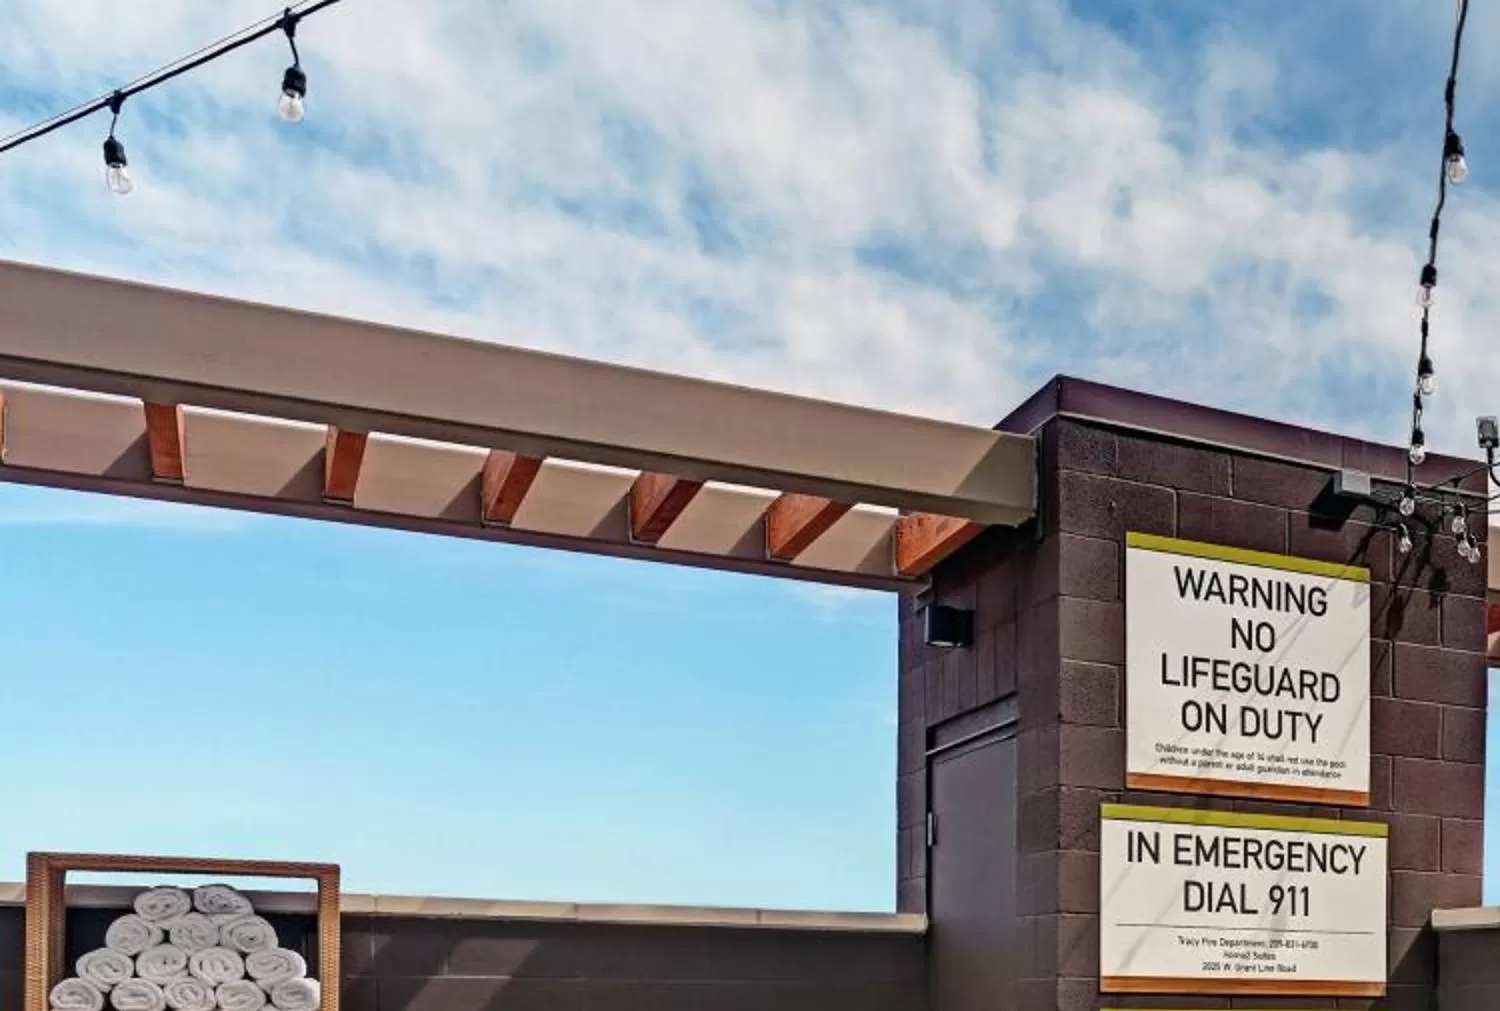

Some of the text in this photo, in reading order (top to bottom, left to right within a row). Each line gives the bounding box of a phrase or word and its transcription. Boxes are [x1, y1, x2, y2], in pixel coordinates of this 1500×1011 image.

[1173, 565, 1328, 616] WARNING
[1231, 617, 1276, 653] NO
[1161, 652, 1340, 703] LIFEGUARD
[1181, 700, 1323, 743] ON DUTY
[1127, 831, 1366, 875] IN EMERGENCY
[1183, 880, 1310, 917] DIAL 911
